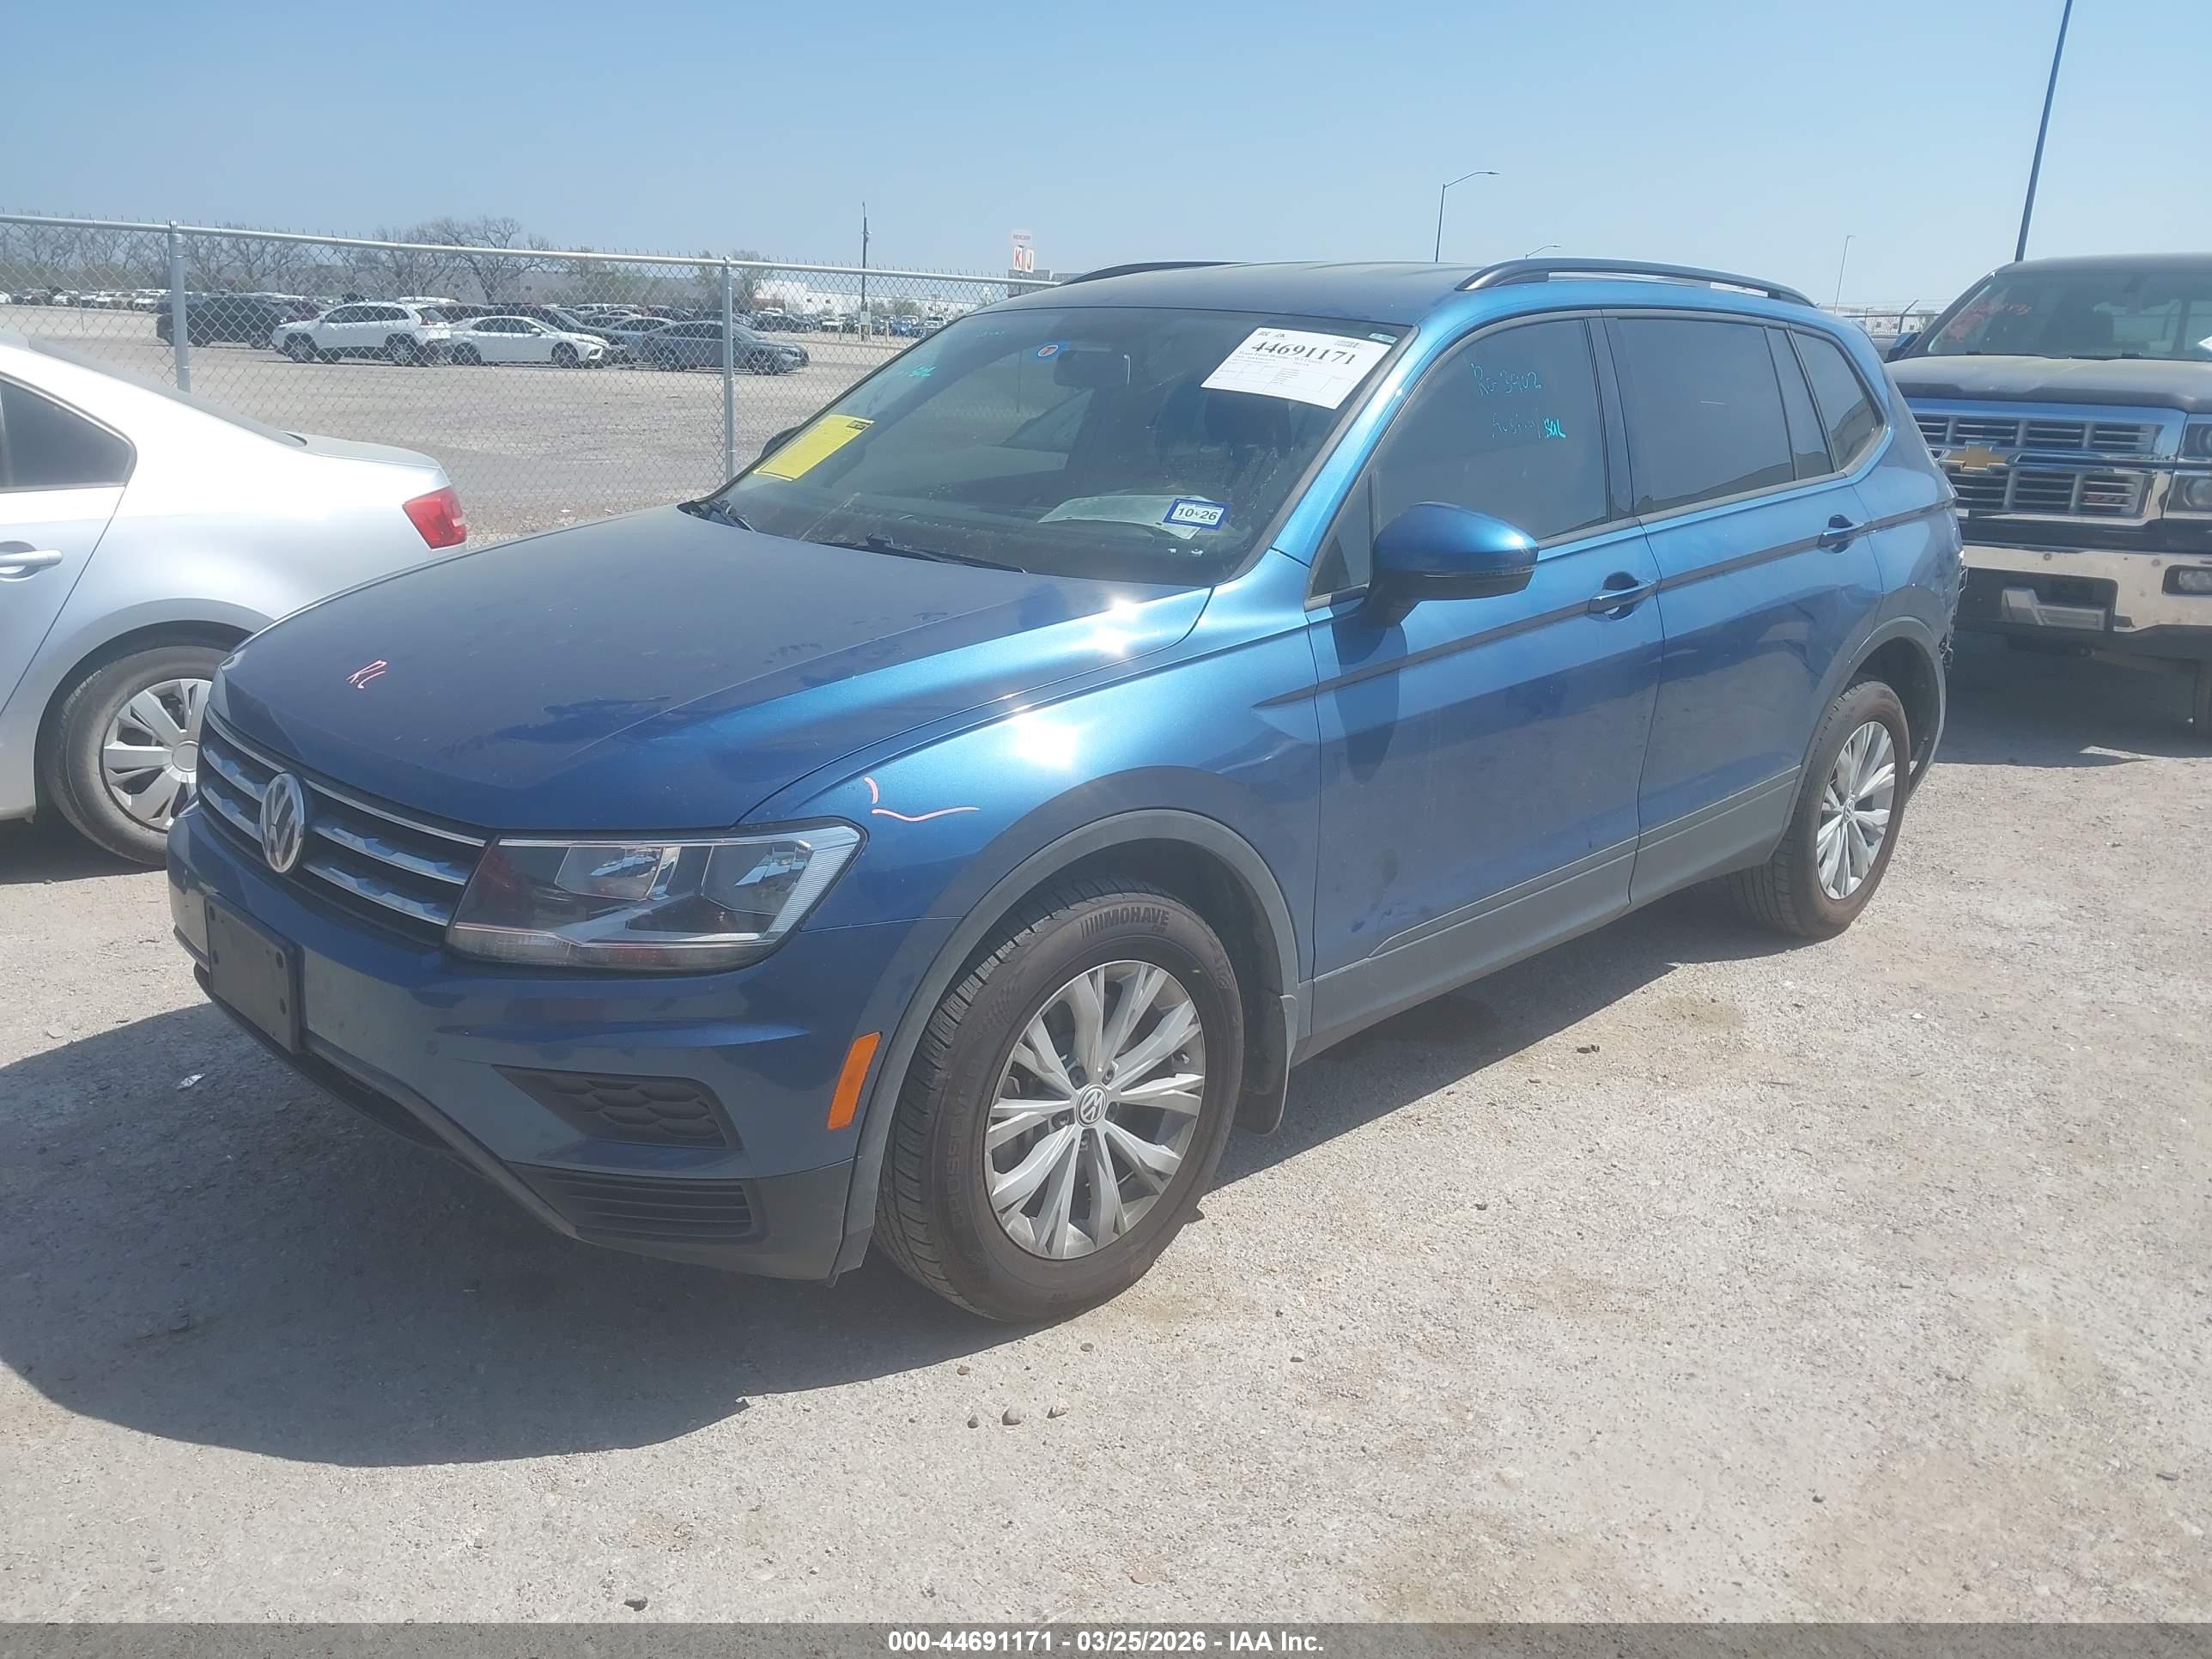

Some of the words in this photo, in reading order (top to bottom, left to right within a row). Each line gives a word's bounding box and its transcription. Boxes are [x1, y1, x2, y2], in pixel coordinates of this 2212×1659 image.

[1252, 341, 1357, 365] 44691171
[260, 773, 305, 873] VW
[1103, 906, 1170, 928] MOHAVE
